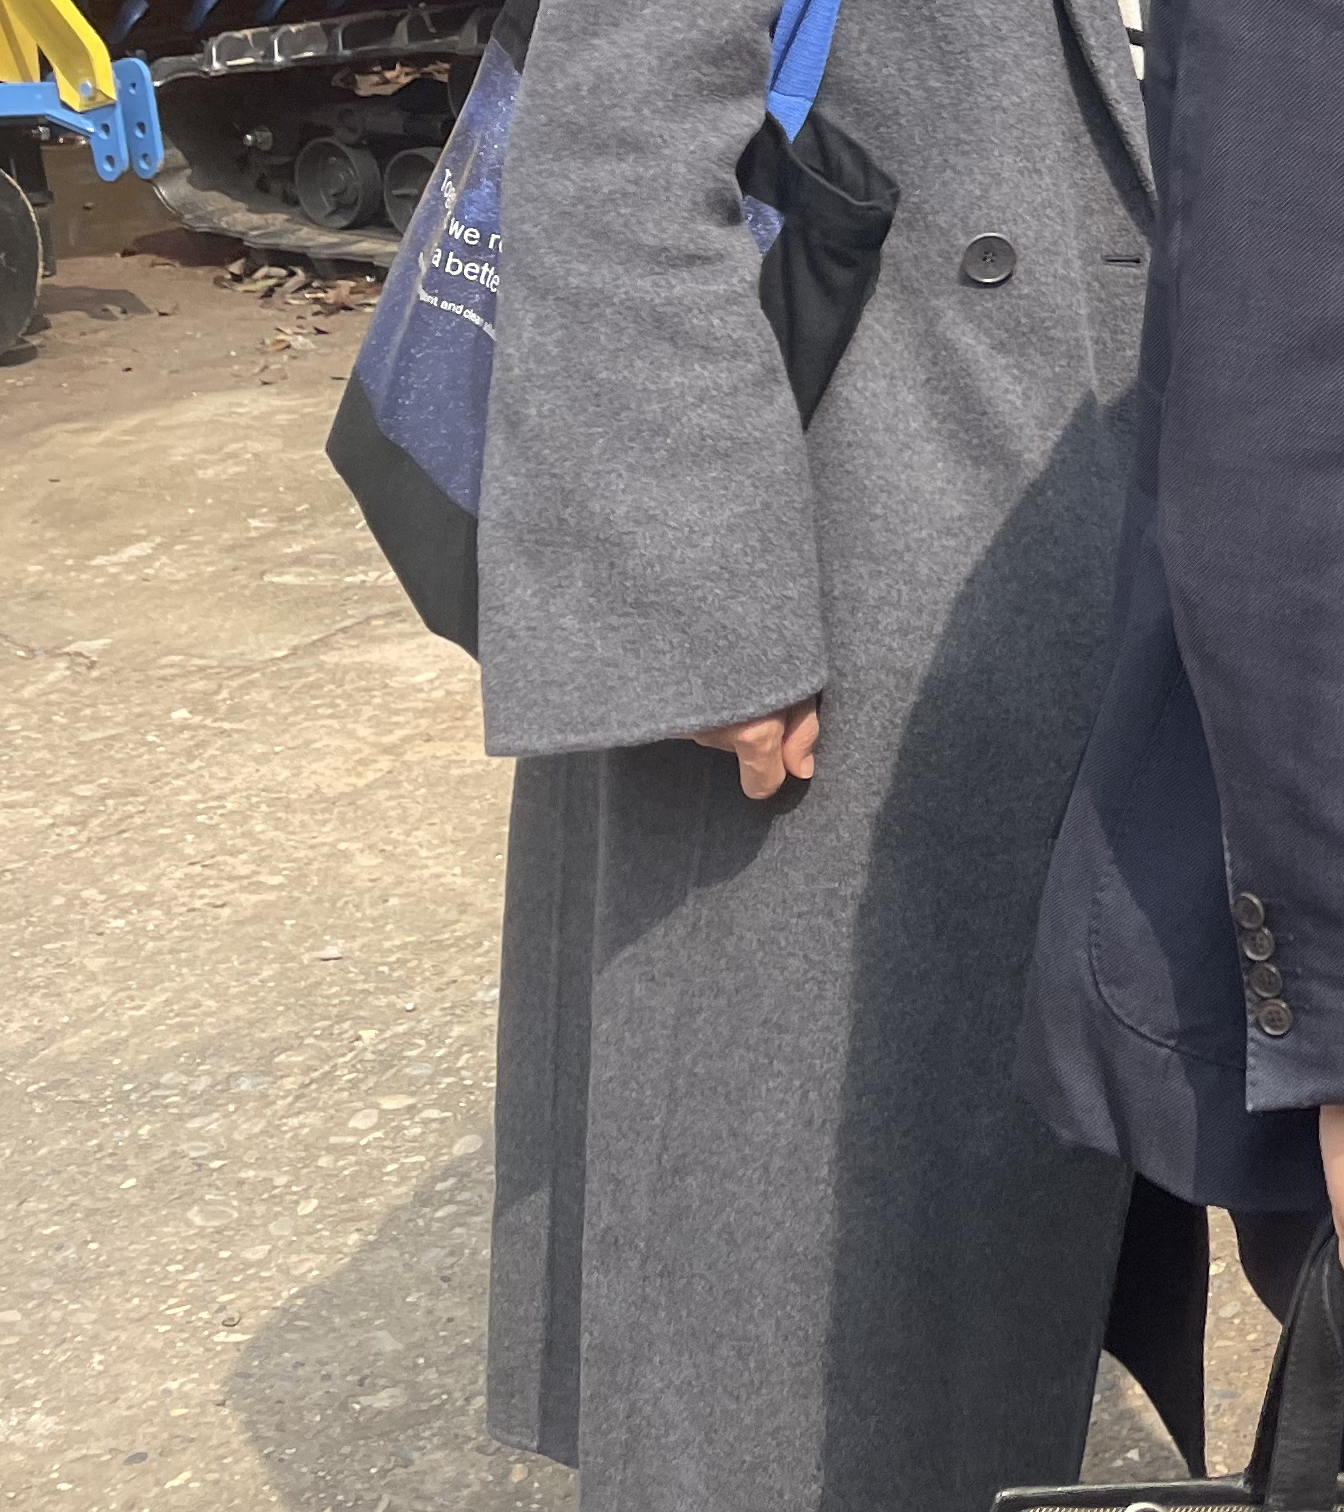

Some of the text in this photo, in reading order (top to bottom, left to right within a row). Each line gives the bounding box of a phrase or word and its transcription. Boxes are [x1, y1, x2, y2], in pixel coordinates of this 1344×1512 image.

[448, 216, 481, 245] we
[432, 248, 442, 268] a
[440, 300, 464, 315] and
